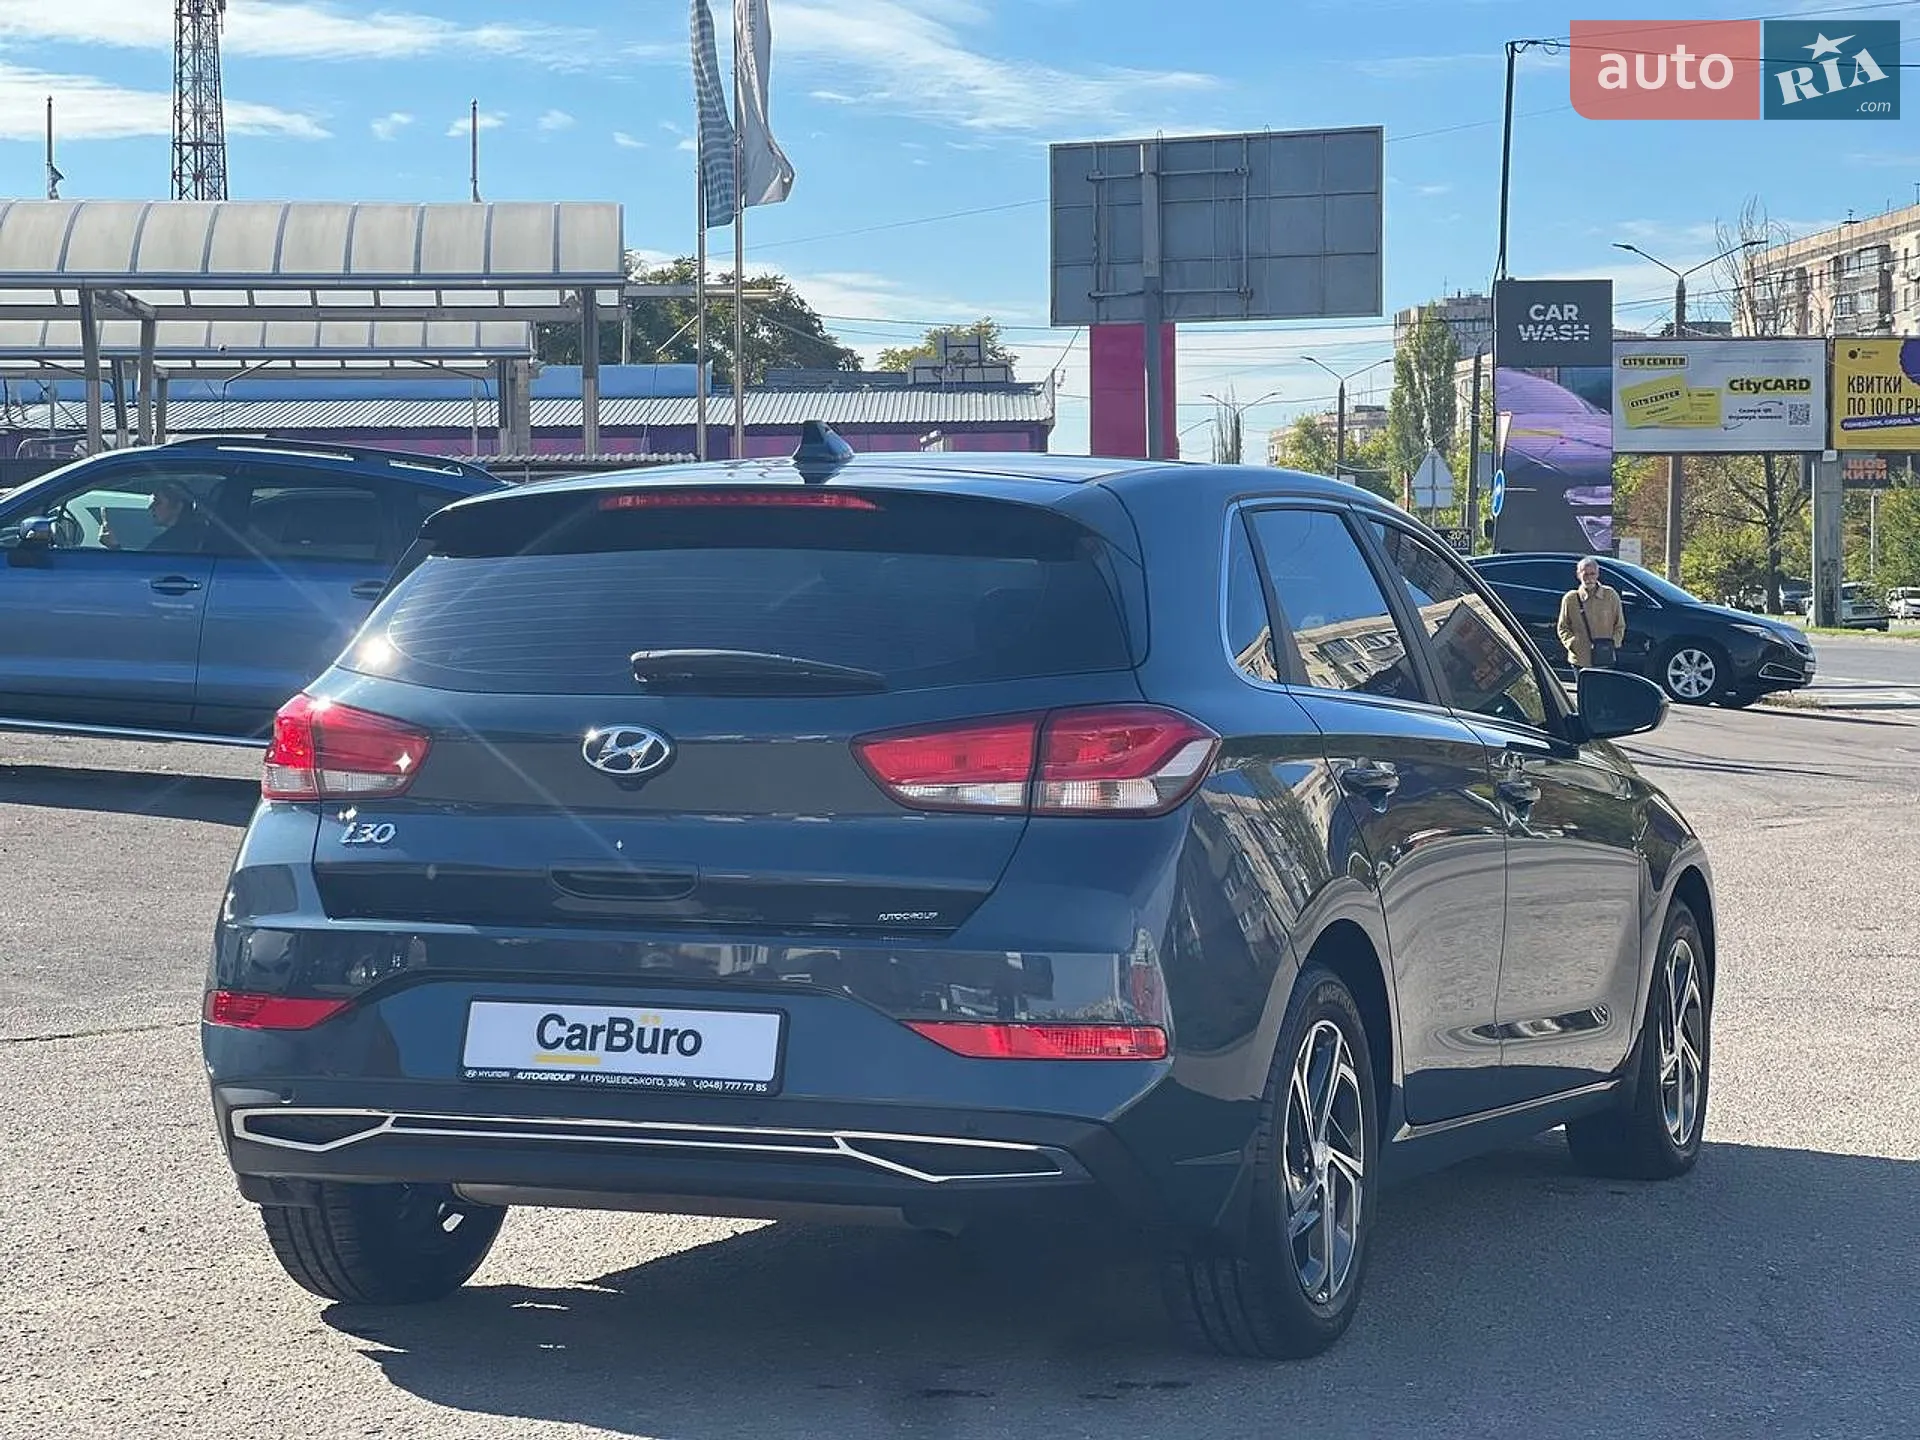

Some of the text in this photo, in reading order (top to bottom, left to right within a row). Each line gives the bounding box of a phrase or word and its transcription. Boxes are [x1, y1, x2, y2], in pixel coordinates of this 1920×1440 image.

[1528, 303, 1579, 321] CAR
[1518, 323, 1590, 341] WASH
[1622, 356, 1686, 366] CITY CENTER
[1728, 378, 1811, 394] CityCARD
[1847, 375, 1902, 394] КВИТКИ
[1649, 389, 1681, 404] CENTER
[1847, 397, 1866, 416] ПО
[1871, 397, 1893, 416] 100
[339, 821, 397, 843] i30
[535, 1012, 703, 1058] CarBüro
[513, 1071, 576, 1082] AUTOGROUP
[699, 1080, 723, 1091] (048)
[724, 1081, 742, 1090] 777
[743, 1082, 755, 1091] 77
[755, 1083, 768, 1092] 85
